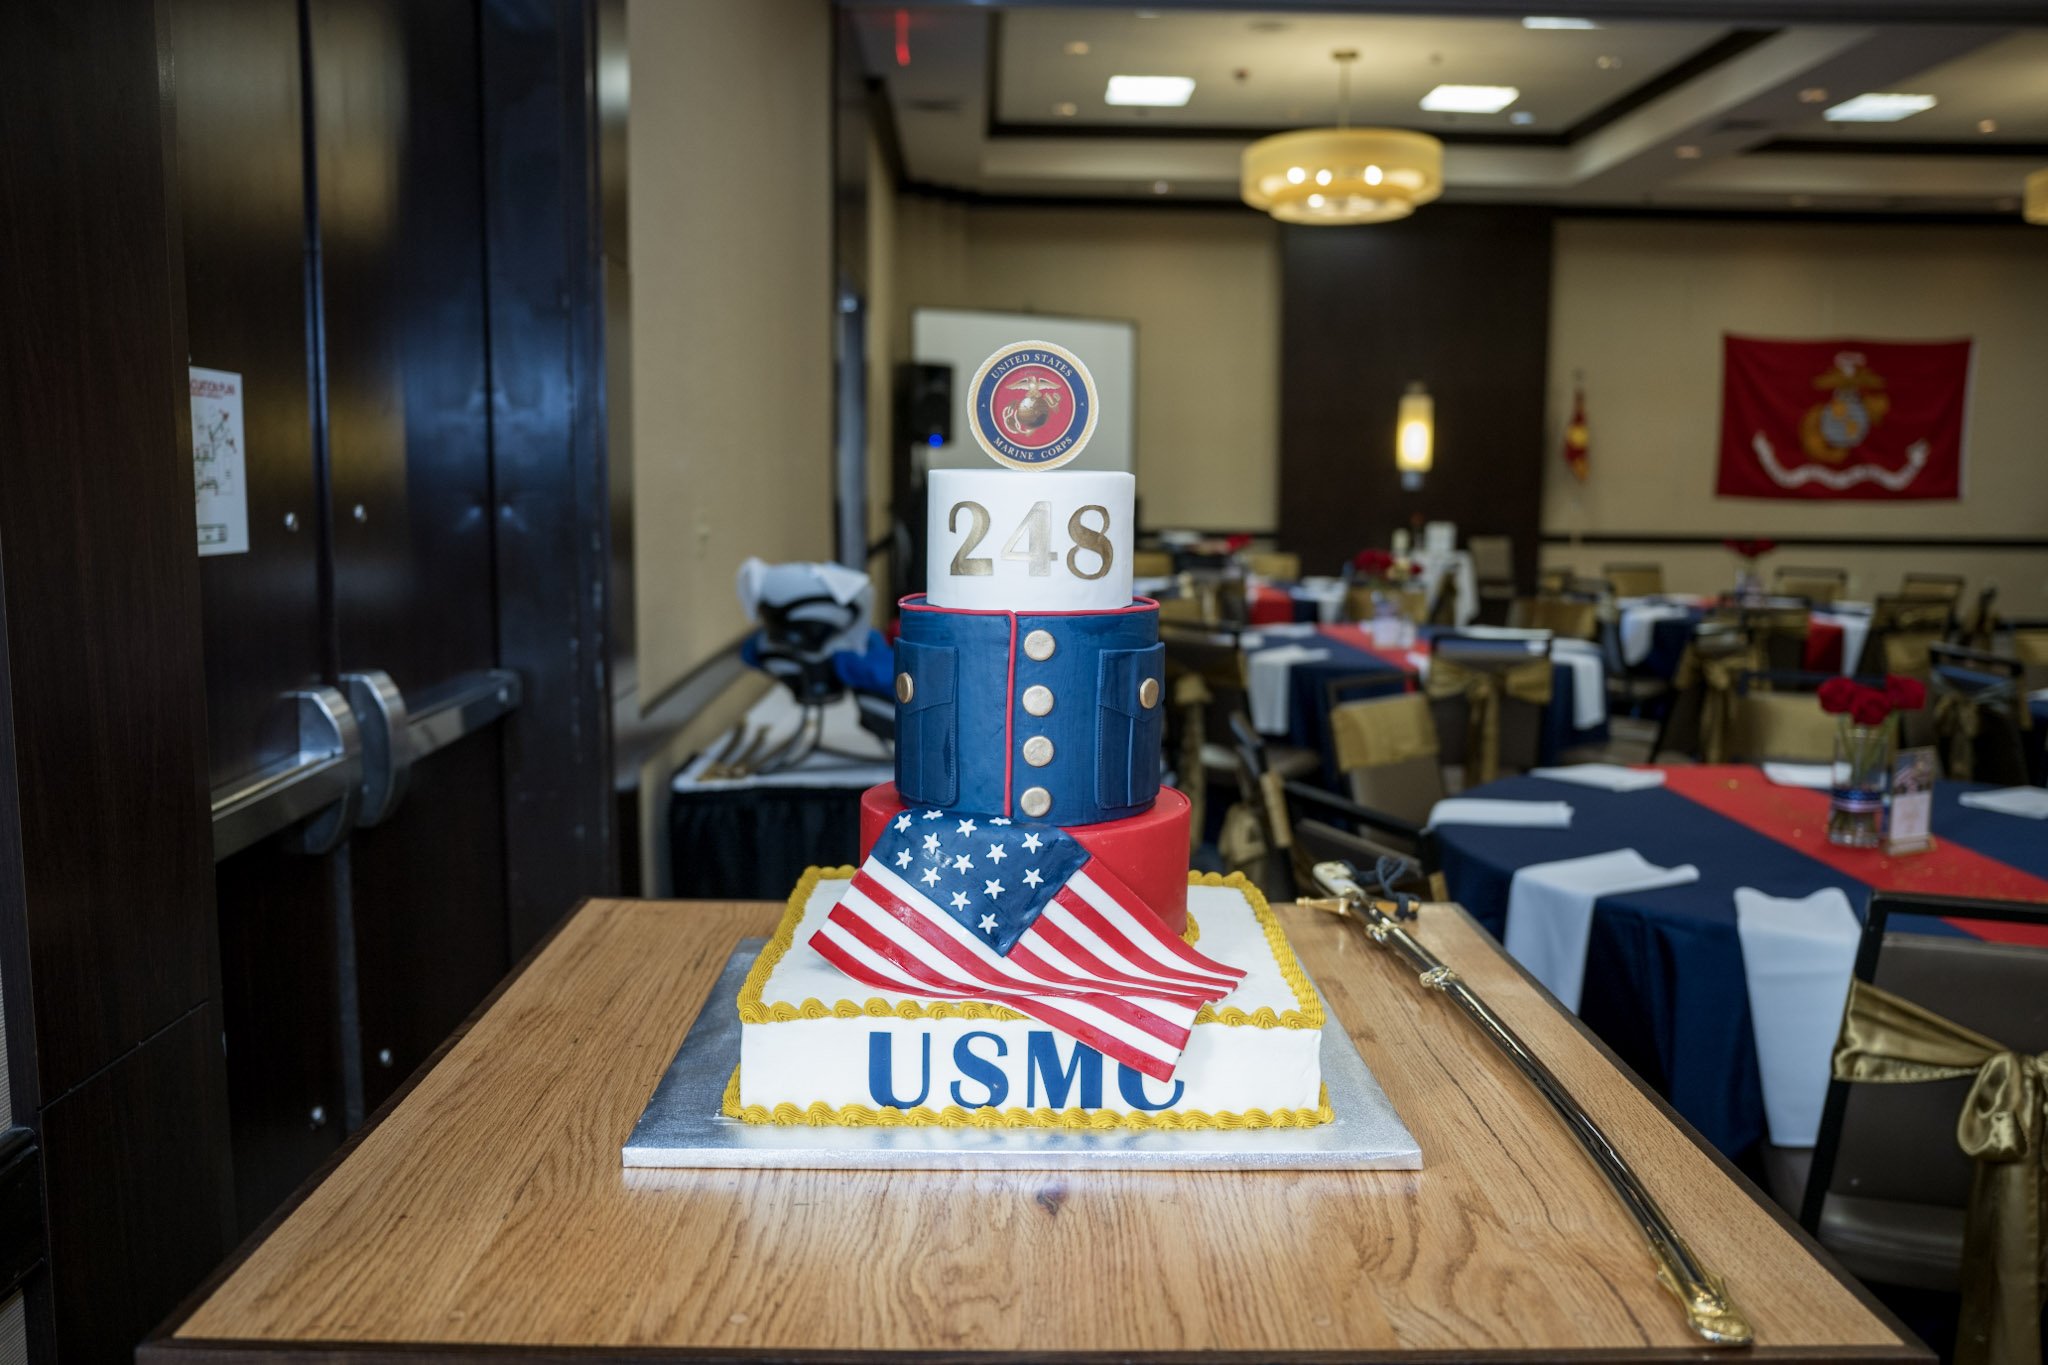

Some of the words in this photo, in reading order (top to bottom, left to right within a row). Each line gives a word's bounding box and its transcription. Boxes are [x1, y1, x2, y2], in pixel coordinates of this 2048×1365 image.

[991, 353, 1030, 379] UNITED
[1034, 353, 1073, 377] STATES
[993, 437, 1034, 460] MARINE
[1041, 436, 1073, 459] CORPS
[948, 501, 1114, 580] 248
